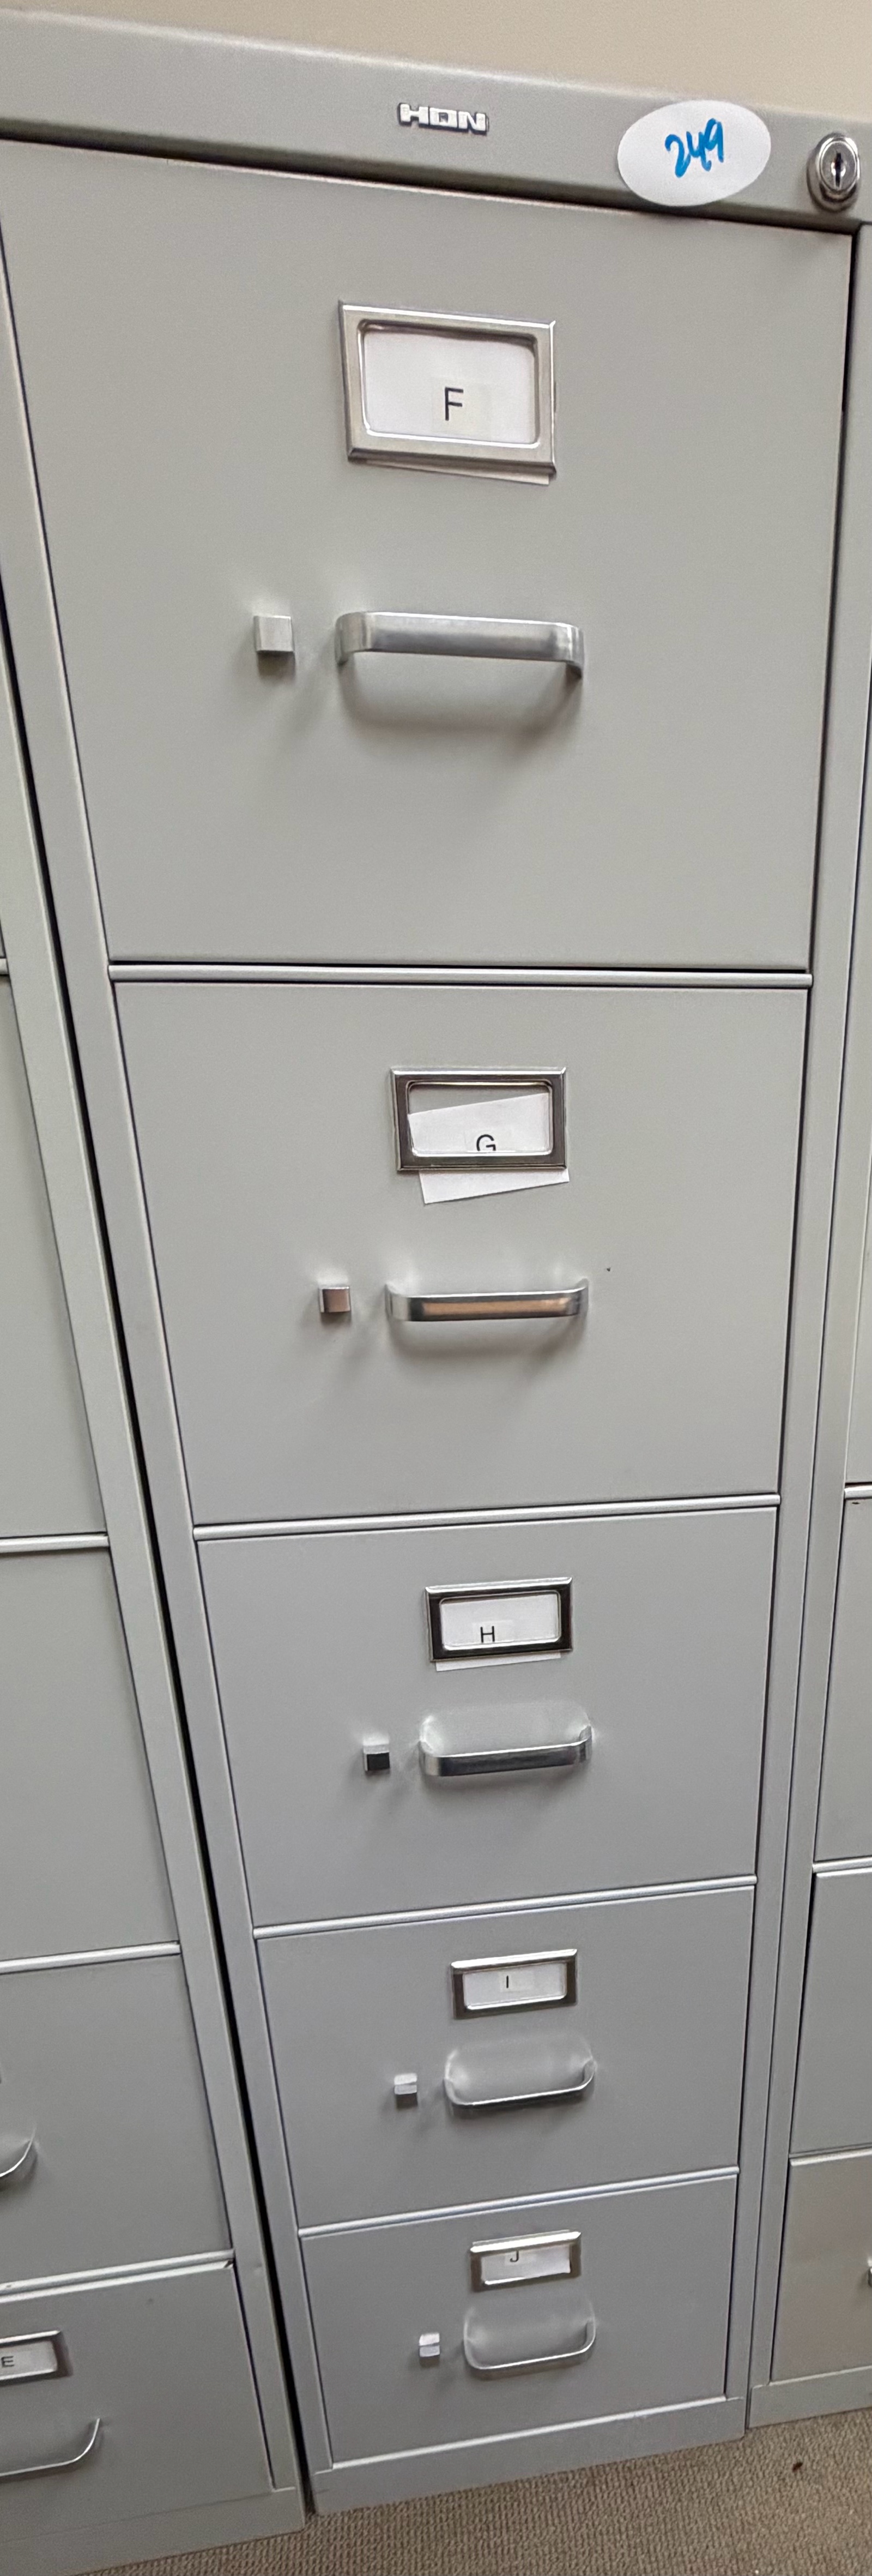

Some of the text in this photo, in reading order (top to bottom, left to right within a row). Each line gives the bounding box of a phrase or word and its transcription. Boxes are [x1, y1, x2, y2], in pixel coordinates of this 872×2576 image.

[398, 103, 488, 132] HON
[665, 118, 724, 178] 249
[444, 386, 463, 421] F
[476, 1134, 496, 1152] G
[480, 1625, 495, 1643] H
[510, 2250, 519, 2262] J
[1, 2355, 14, 2368] E
